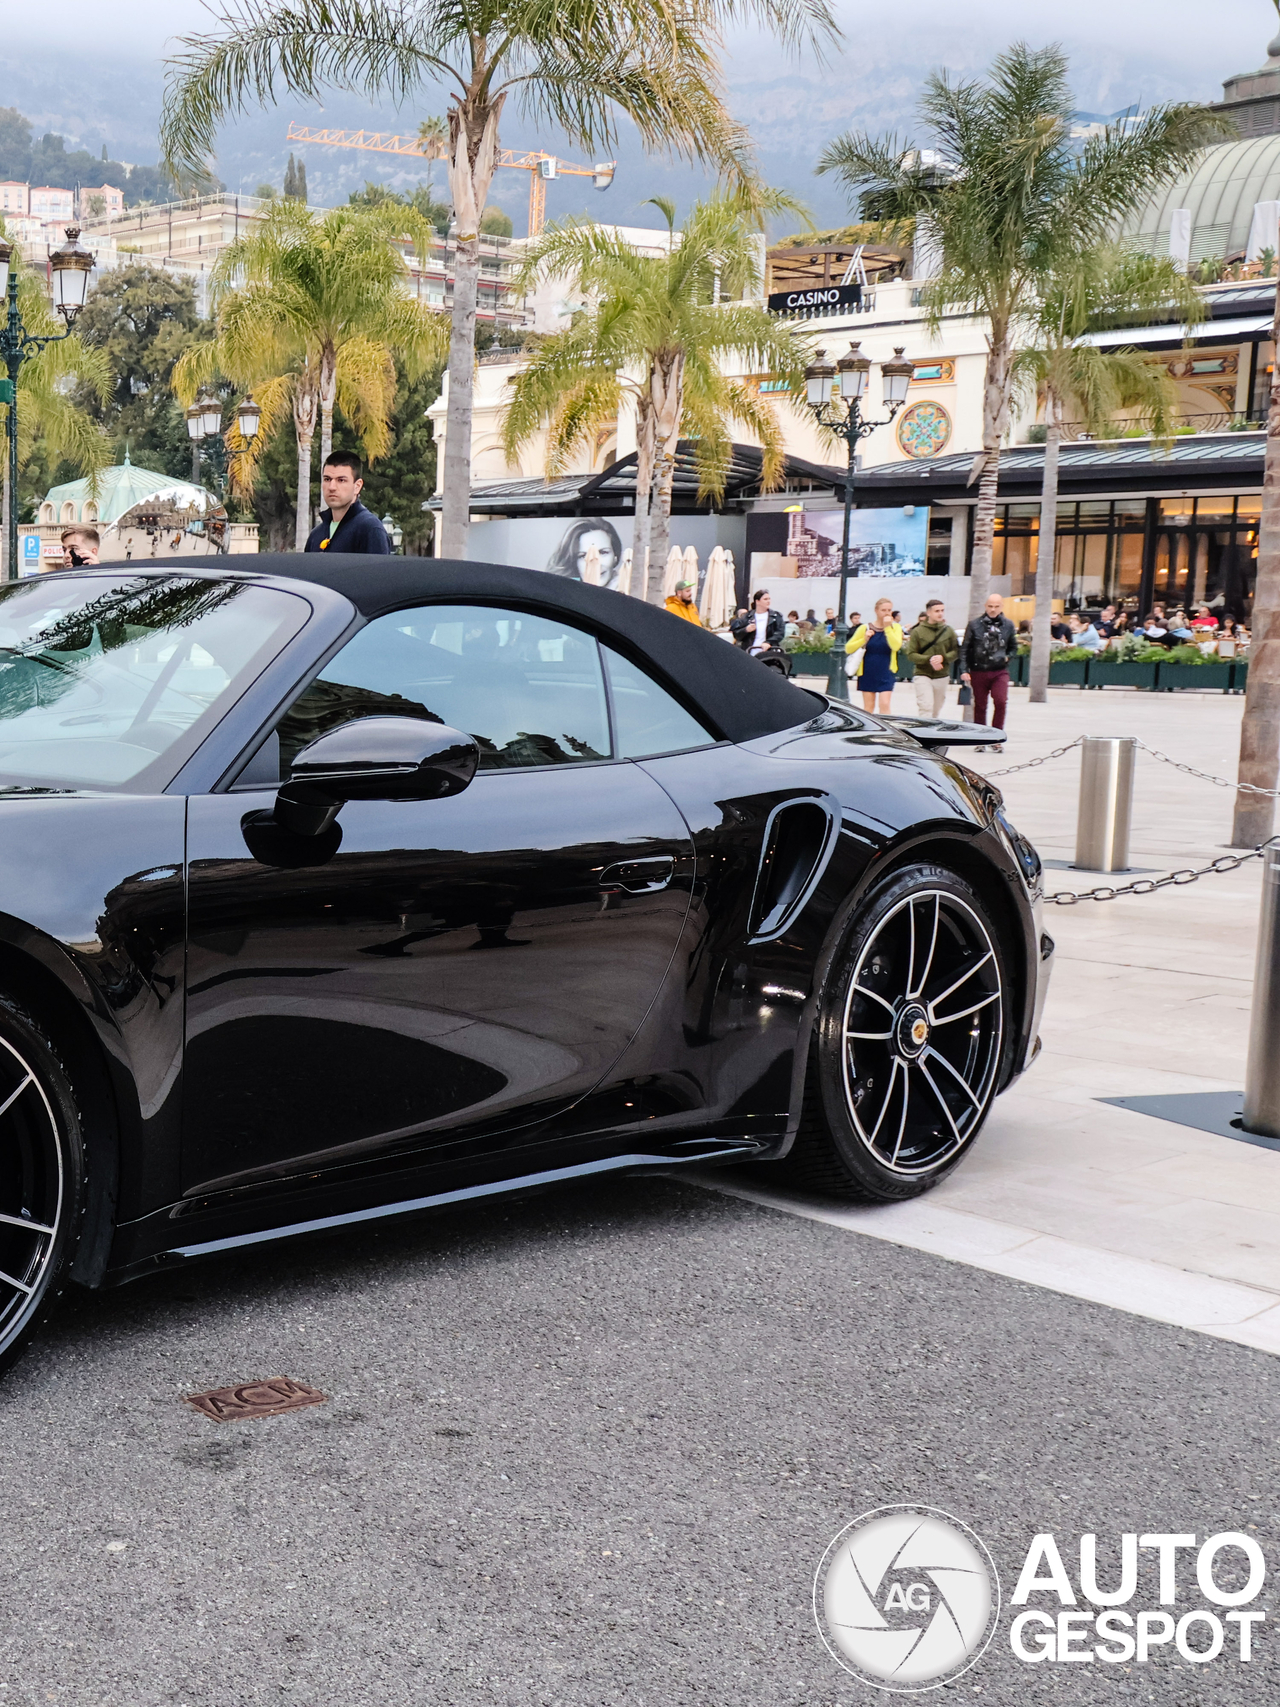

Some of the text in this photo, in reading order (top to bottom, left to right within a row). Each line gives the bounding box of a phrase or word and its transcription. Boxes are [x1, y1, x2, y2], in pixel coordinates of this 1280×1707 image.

[787, 289, 840, 308] CASINO
[27, 538, 36, 551] P
[208, 1381, 313, 1414] ACM
